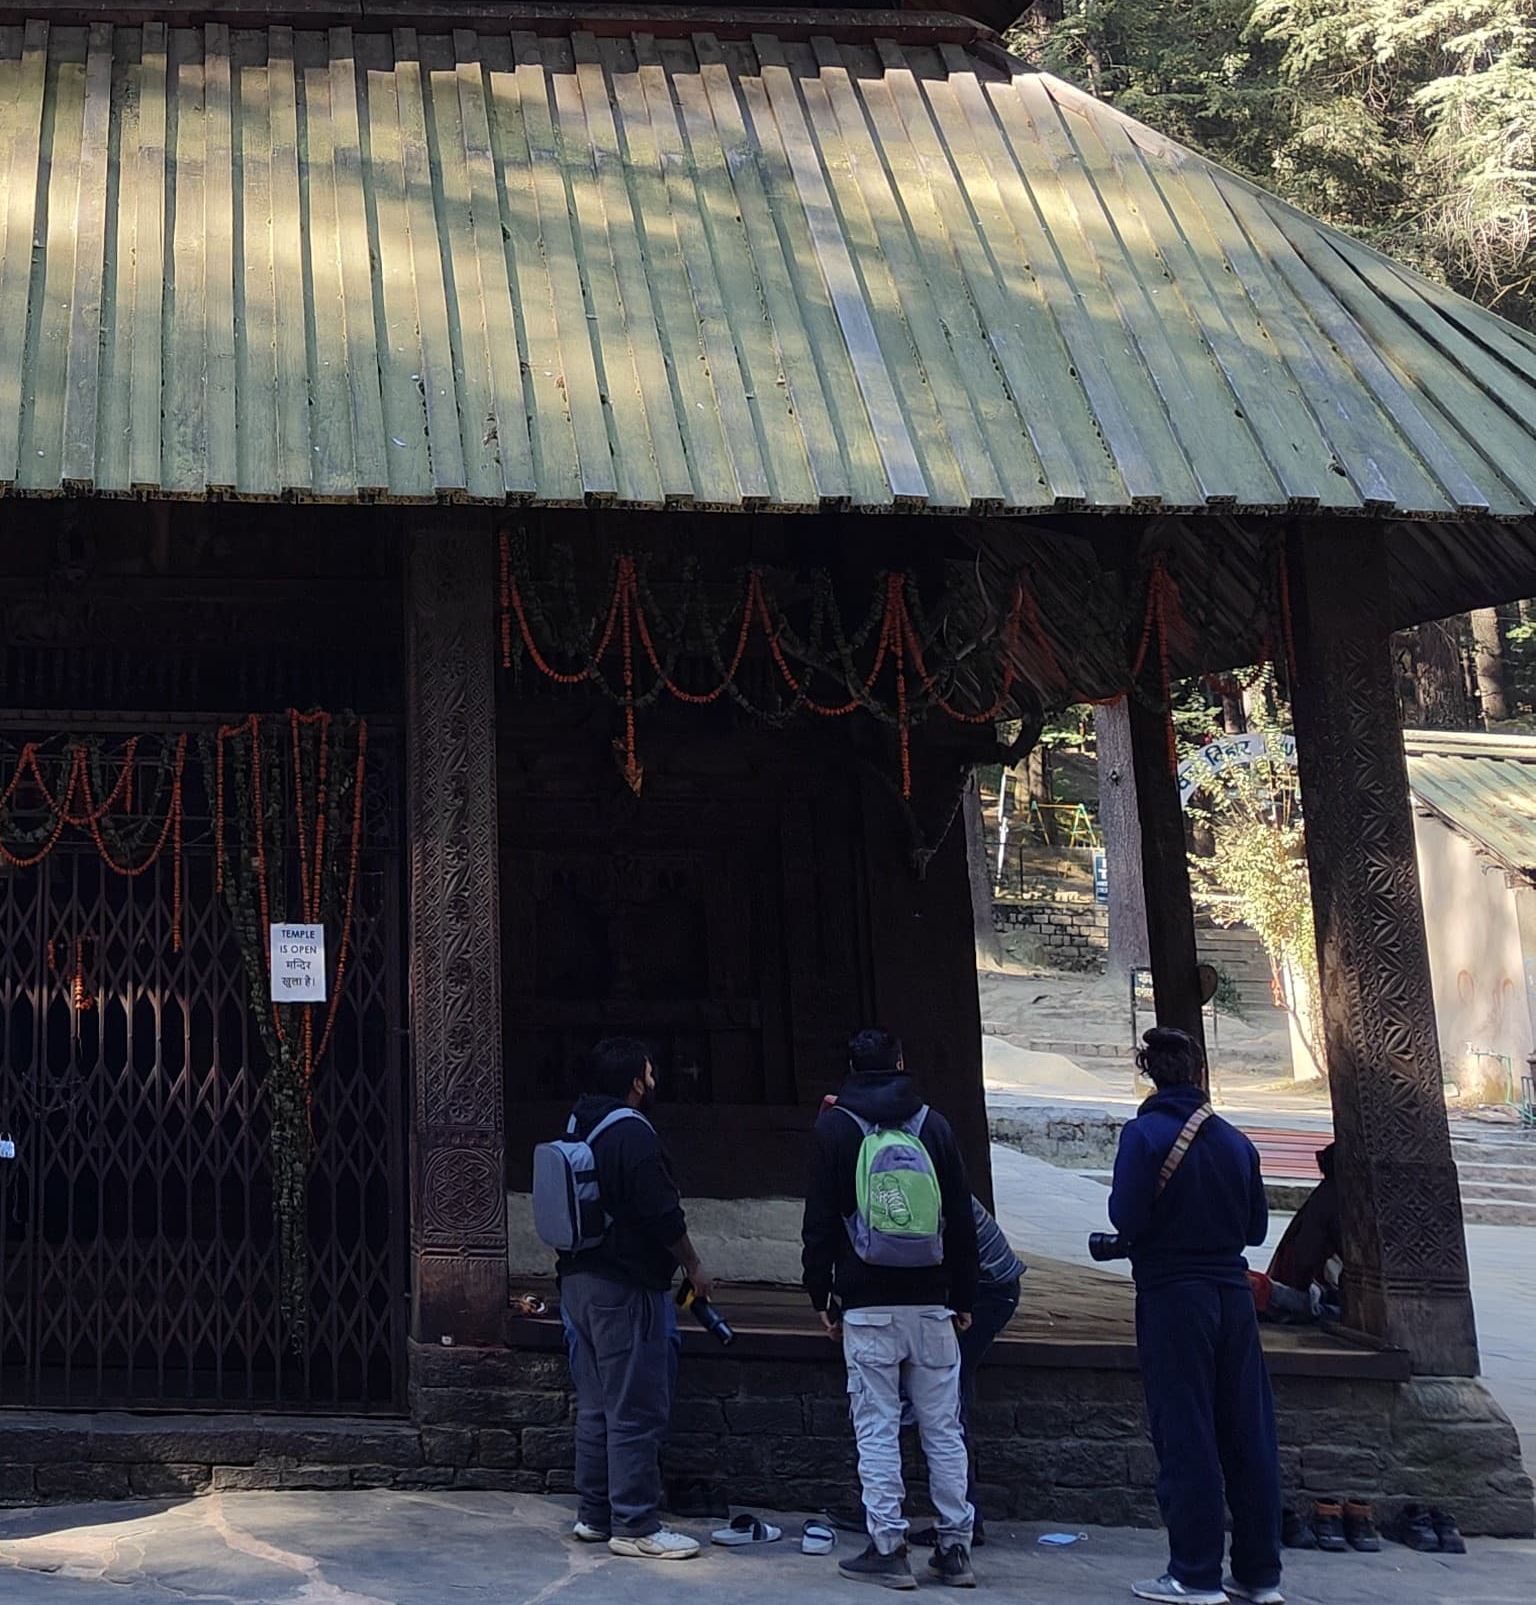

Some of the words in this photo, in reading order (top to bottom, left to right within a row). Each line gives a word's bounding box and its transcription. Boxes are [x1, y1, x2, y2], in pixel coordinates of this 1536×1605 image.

[281, 930, 316, 939] TEMPLE
[280, 945, 288, 954] IS
[290, 945, 317, 954] OPEN
